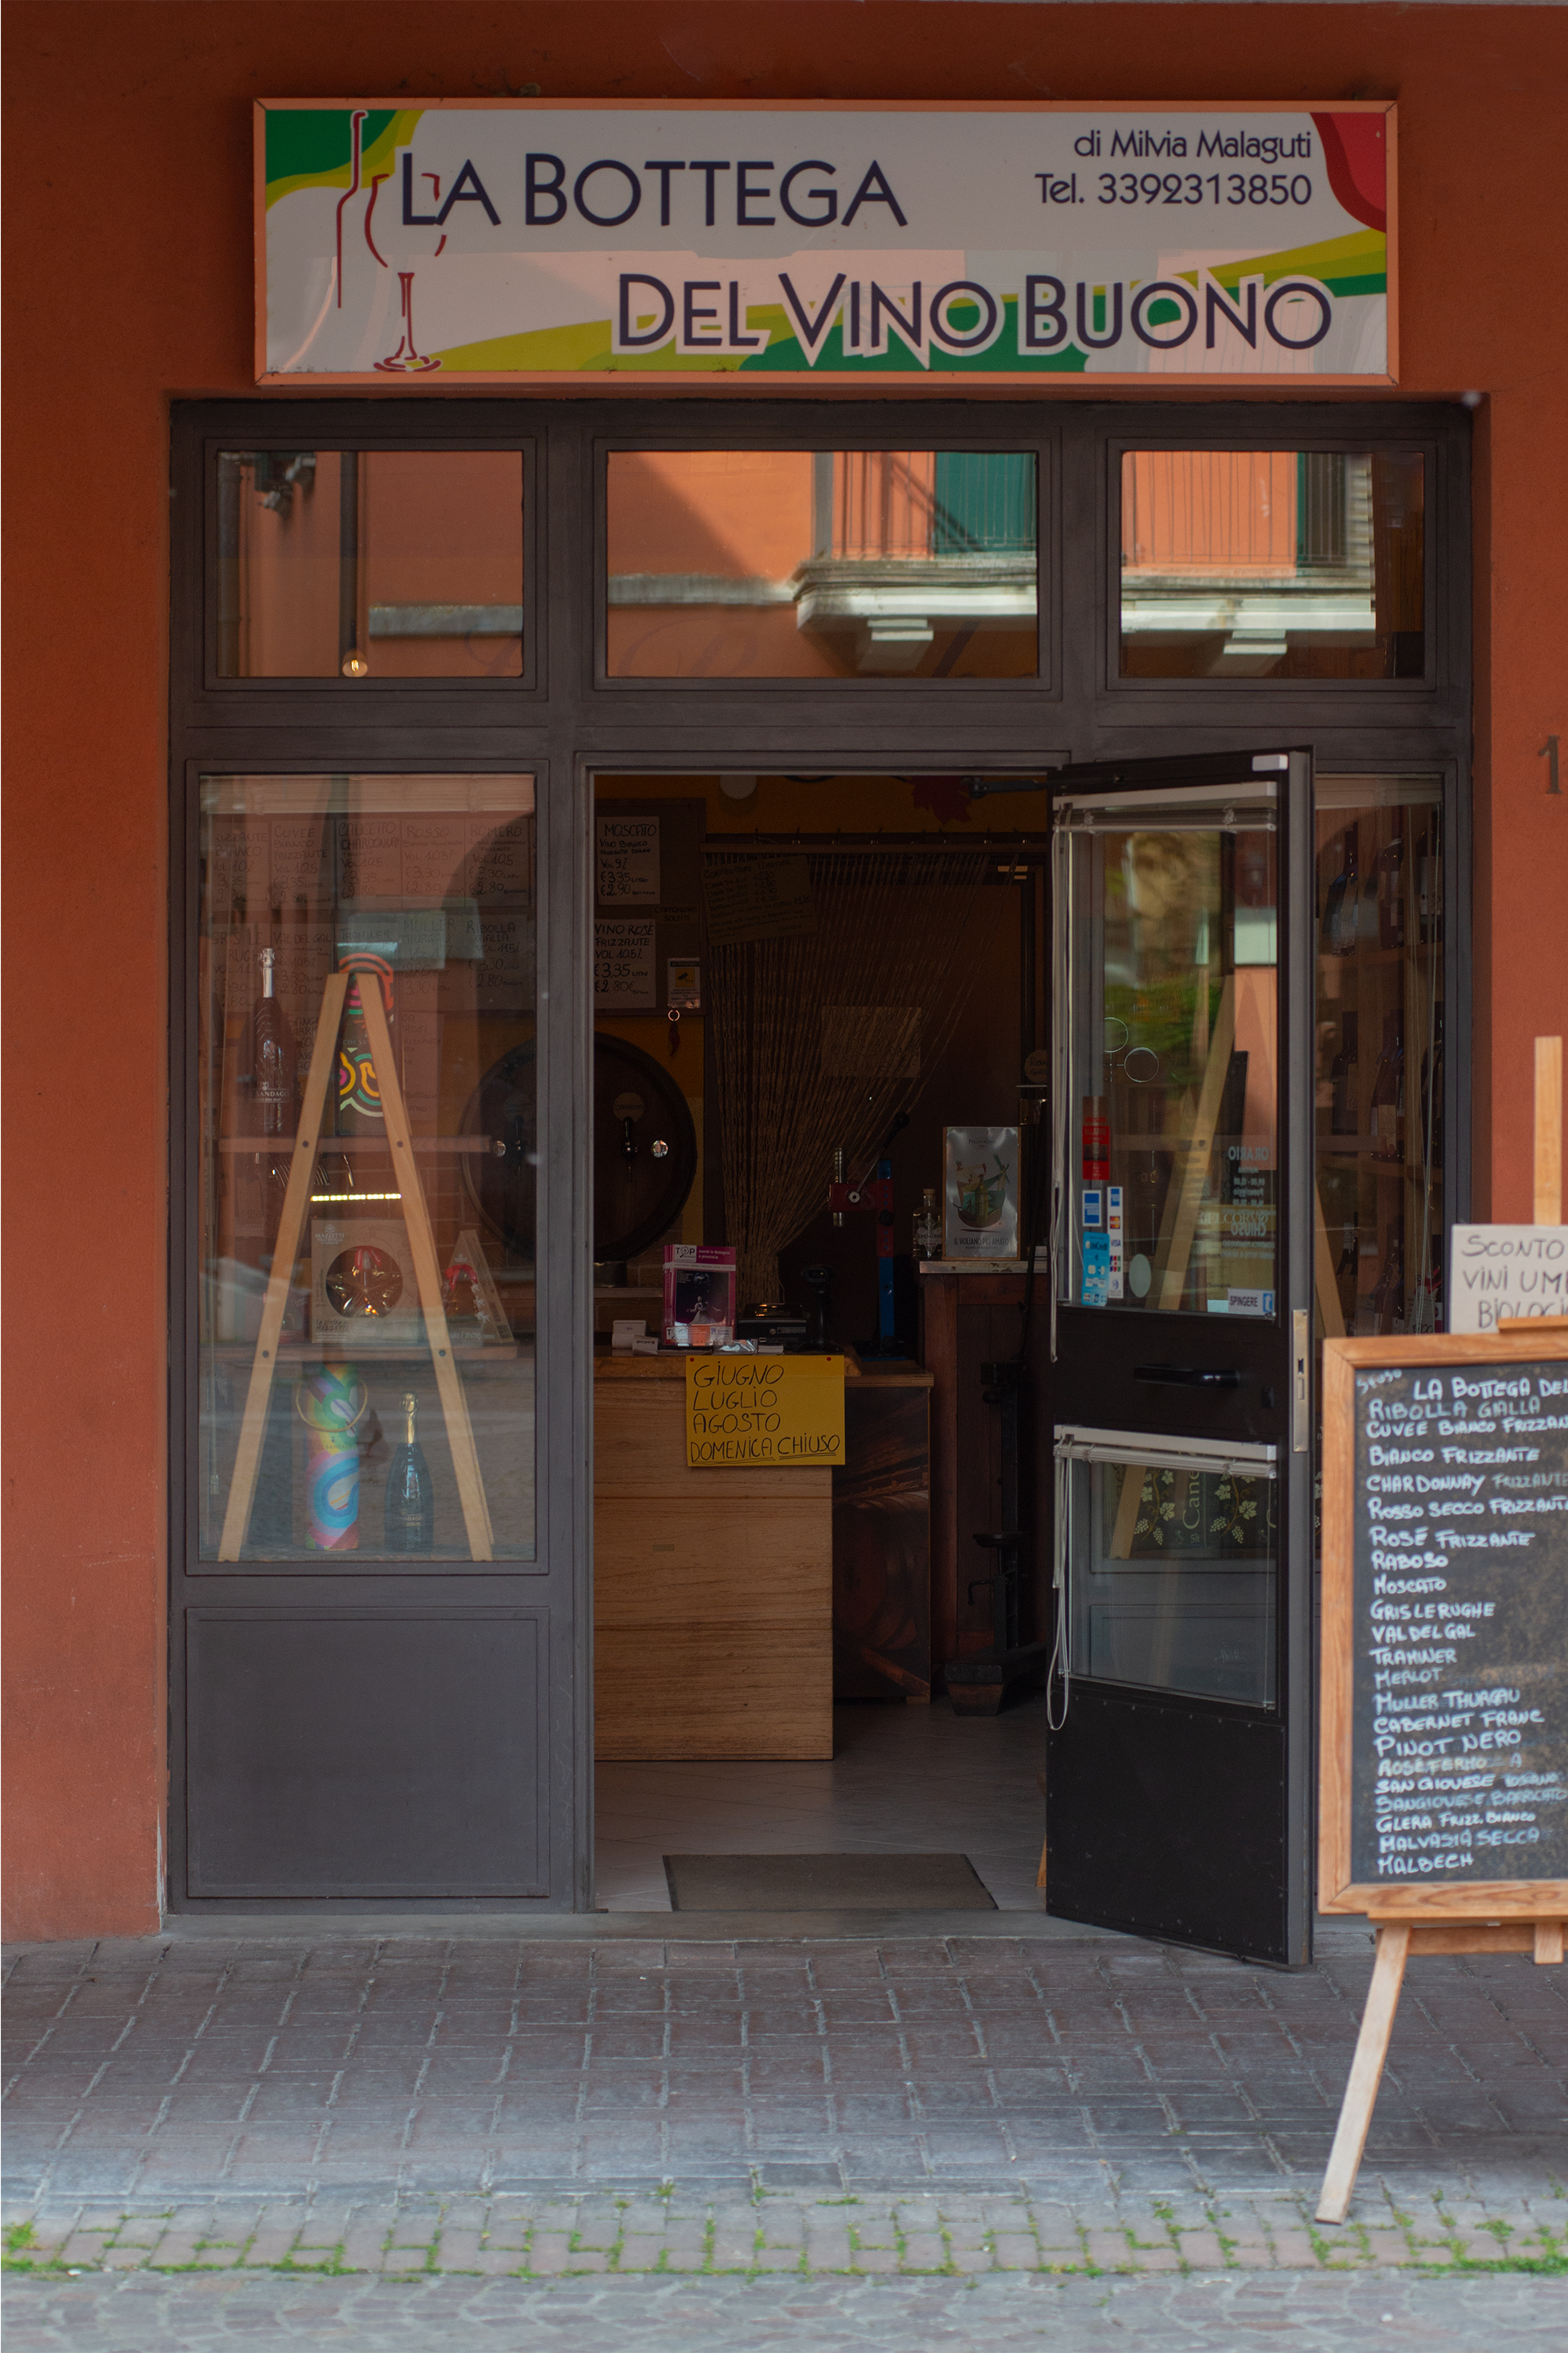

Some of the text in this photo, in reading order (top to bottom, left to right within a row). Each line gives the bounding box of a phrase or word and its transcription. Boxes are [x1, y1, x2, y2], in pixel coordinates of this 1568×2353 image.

[1074, 129, 1312, 164] di Milvia Malaguti
[402, 152, 909, 229] LA BOTTEGA
[1034, 172, 1313, 206] Tel. 3392313850
[619, 272, 1333, 351] DEL VINO BUONO
[274, 824, 315, 839] CUVEE
[406, 825, 451, 839] ROSSO
[604, 823, 657, 837] MOSCATO
[274, 848, 328, 860] FRIZZANTE
[599, 838, 648, 848] VINO BIANCO
[594, 921, 654, 936] VINO ROSÉ
[594, 937, 651, 947] FRIZZANTE
[595, 949, 615, 959] VOL
[1461, 1234, 1566, 1260] SCONTO
[1462, 1264, 1509, 1292] VINI
[1229, 1295, 1259, 1307] SPINGERE
[693, 1360, 785, 1388] GIUGNO
[692, 1385, 778, 1411] LUGLIO
[1413, 1377, 1443, 1400] LA
[1451, 1375, 1531, 1399] BOTTEGA
[1369, 1395, 1541, 1421] RIBOLLA GIALLA
[692, 1412, 781, 1434] AGOSTO
[1366, 1419, 1428, 1439] CUVEE
[1438, 1420, 1497, 1436] BIANCO
[690, 1432, 840, 1463] DOMENICA CHIUSO
[1369, 1444, 1541, 1467] BIANCO FRIZZANTE
[1366, 1472, 1486, 1497] CHARDONNAY
[1367, 1494, 1568, 1520] ROSSO SECCO FRIZZANT
[1367, 1525, 1537, 1550] ROSÉ FRIZZANTE
[1370, 1549, 1449, 1571] RABOSO
[1373, 1571, 1448, 1595] MOSCATO
[1370, 1598, 1412, 1621] GRIS
[1437, 1601, 1497, 1620] RUGHE
[1371, 1621, 1476, 1644] VAL DEL GAL
[1367, 1646, 1458, 1667] TRAMINER
[1373, 1666, 1444, 1691] MERLOT
[1372, 1686, 1521, 1717] MULLER THURGAU
[1373, 1707, 1546, 1735] CABERNET FRANC
[1372, 1728, 1522, 1759] PINOT NERO
[1374, 1790, 1487, 1814] SANGIOVESE
[1374, 1813, 1434, 1834] GLERA
[1485, 1810, 1537, 1825] BIANCO
[1378, 1825, 1541, 1855] MALVASIA SECCA
[1376, 1850, 1475, 1876] MALBECH
